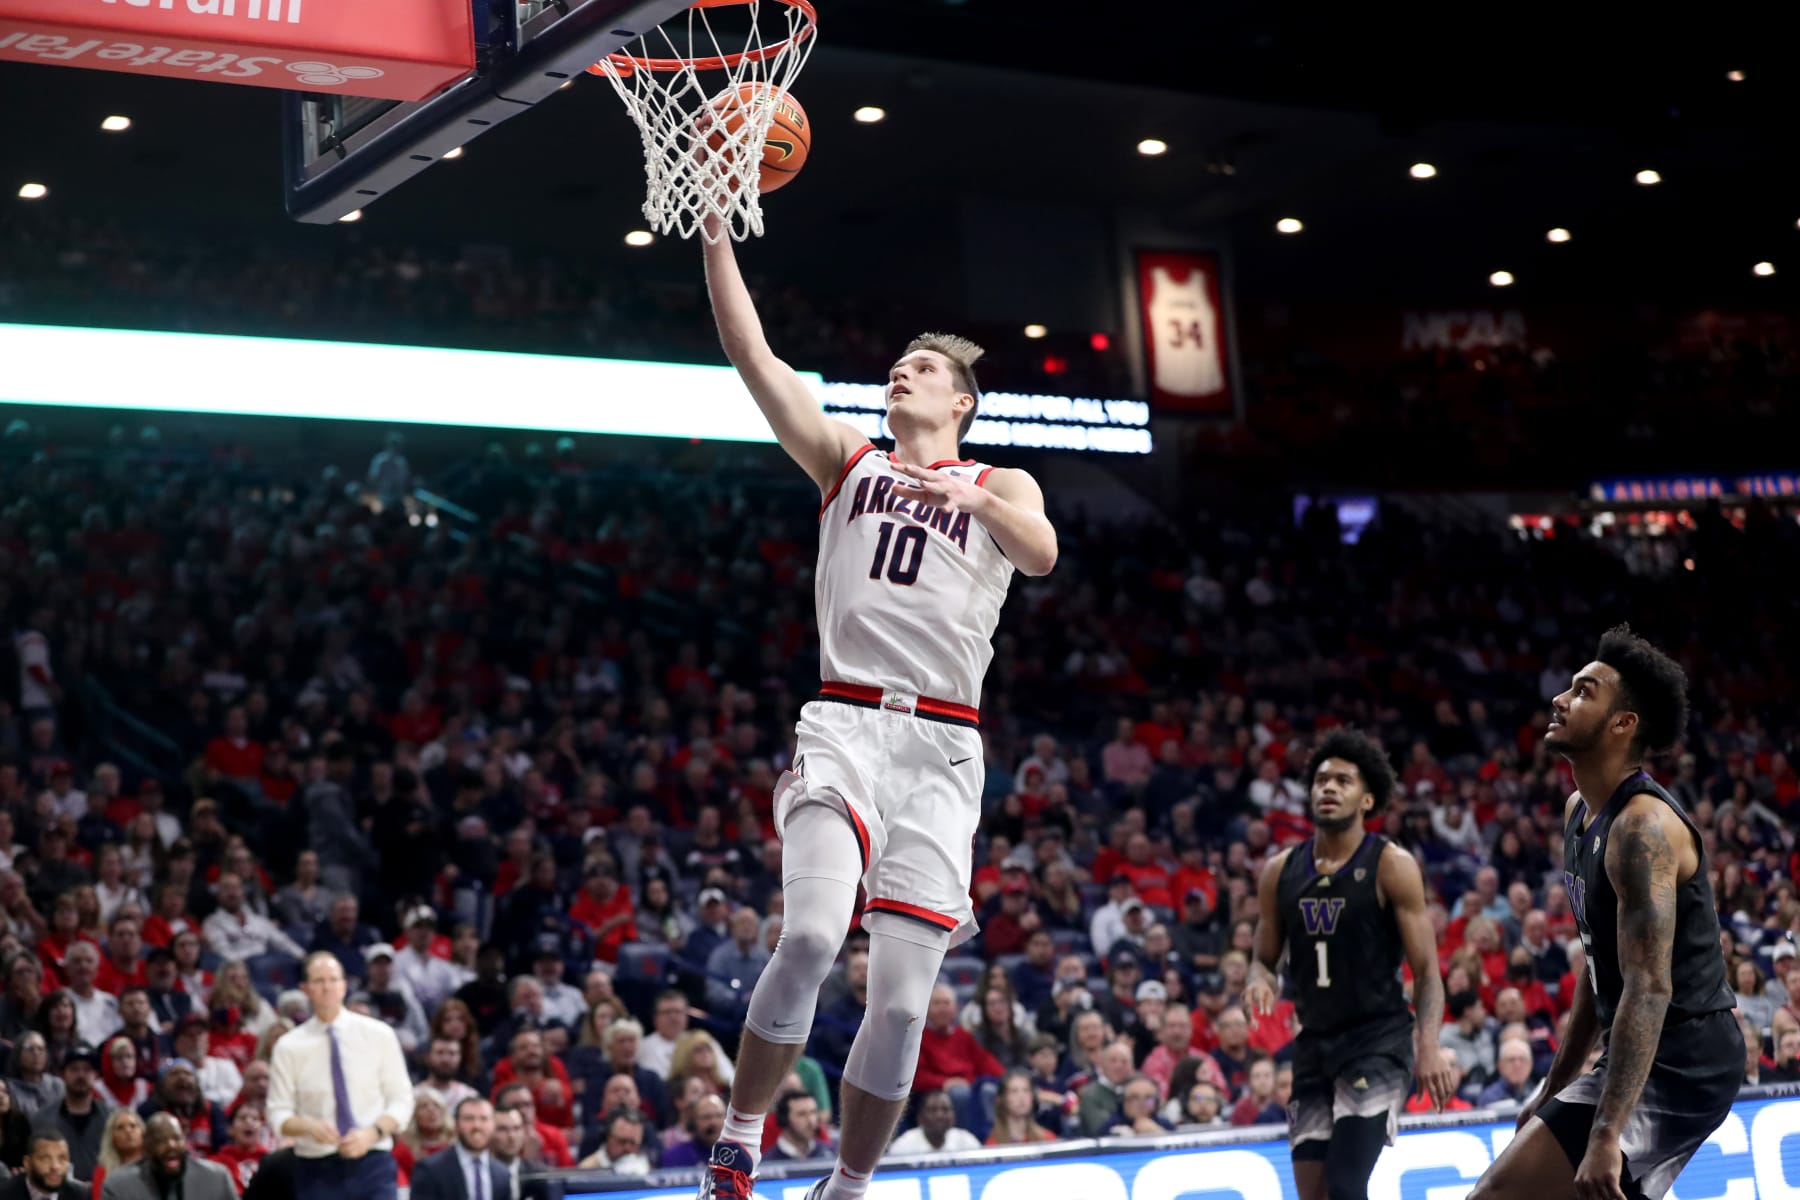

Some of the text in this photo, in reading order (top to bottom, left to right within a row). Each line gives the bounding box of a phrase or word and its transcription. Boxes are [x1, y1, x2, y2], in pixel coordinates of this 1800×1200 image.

[1168, 319, 1203, 349] 34
[847, 475, 971, 556] ARIZONA
[869, 521, 928, 586] 10
[1298, 897, 1346, 935] W
[1314, 941, 1331, 988] 1
